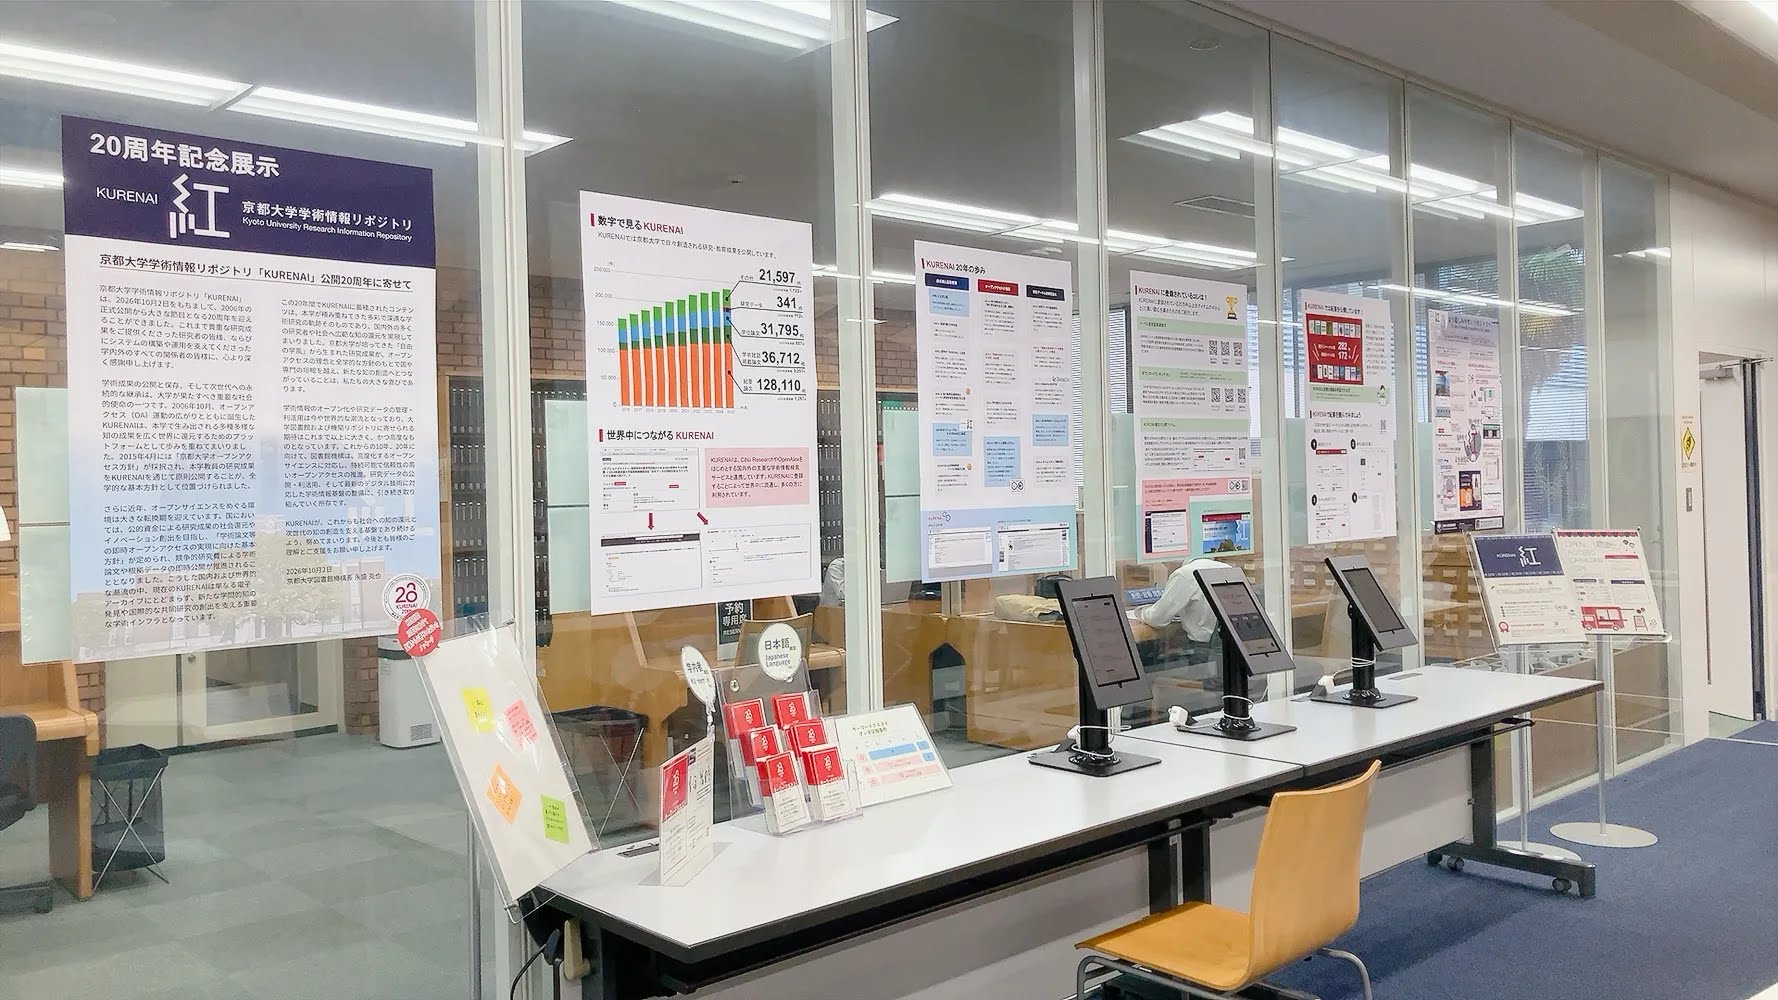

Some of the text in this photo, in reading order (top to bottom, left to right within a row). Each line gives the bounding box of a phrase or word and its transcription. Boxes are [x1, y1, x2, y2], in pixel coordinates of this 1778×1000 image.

[90, 133, 280, 178] 20周年記念展示
[96, 186, 158, 205] KURENAI
[242, 200, 412, 231] 京都大学学術情報リポジトリ
[242, 216, 412, 243] Kyoto University Research Information Repository
[598, 215, 683, 235] 数字で見るKURENAI
[100, 253, 412, 290] 京都大学学術情報リポジトリ「KURENAI」公開20周年に寄せて
[926, 260, 986, 274] KURENAI 20年の歩み
[759, 269, 795, 283] 21,597
[777, 296, 796, 308] 341
[761, 323, 799, 337] 31,795
[103, 359, 175, 368] く感謝申し上げます。
[762, 351, 800, 365] 36,712
[757, 379, 800, 392] 128,110
[607, 429, 714, 441] 世界中につながる KURENAI
[725, 601, 744, 615] 予約
[764, 638, 789, 651] 日本語
[765, 653, 788, 661] Japanese
[766, 659, 791, 667] Language
